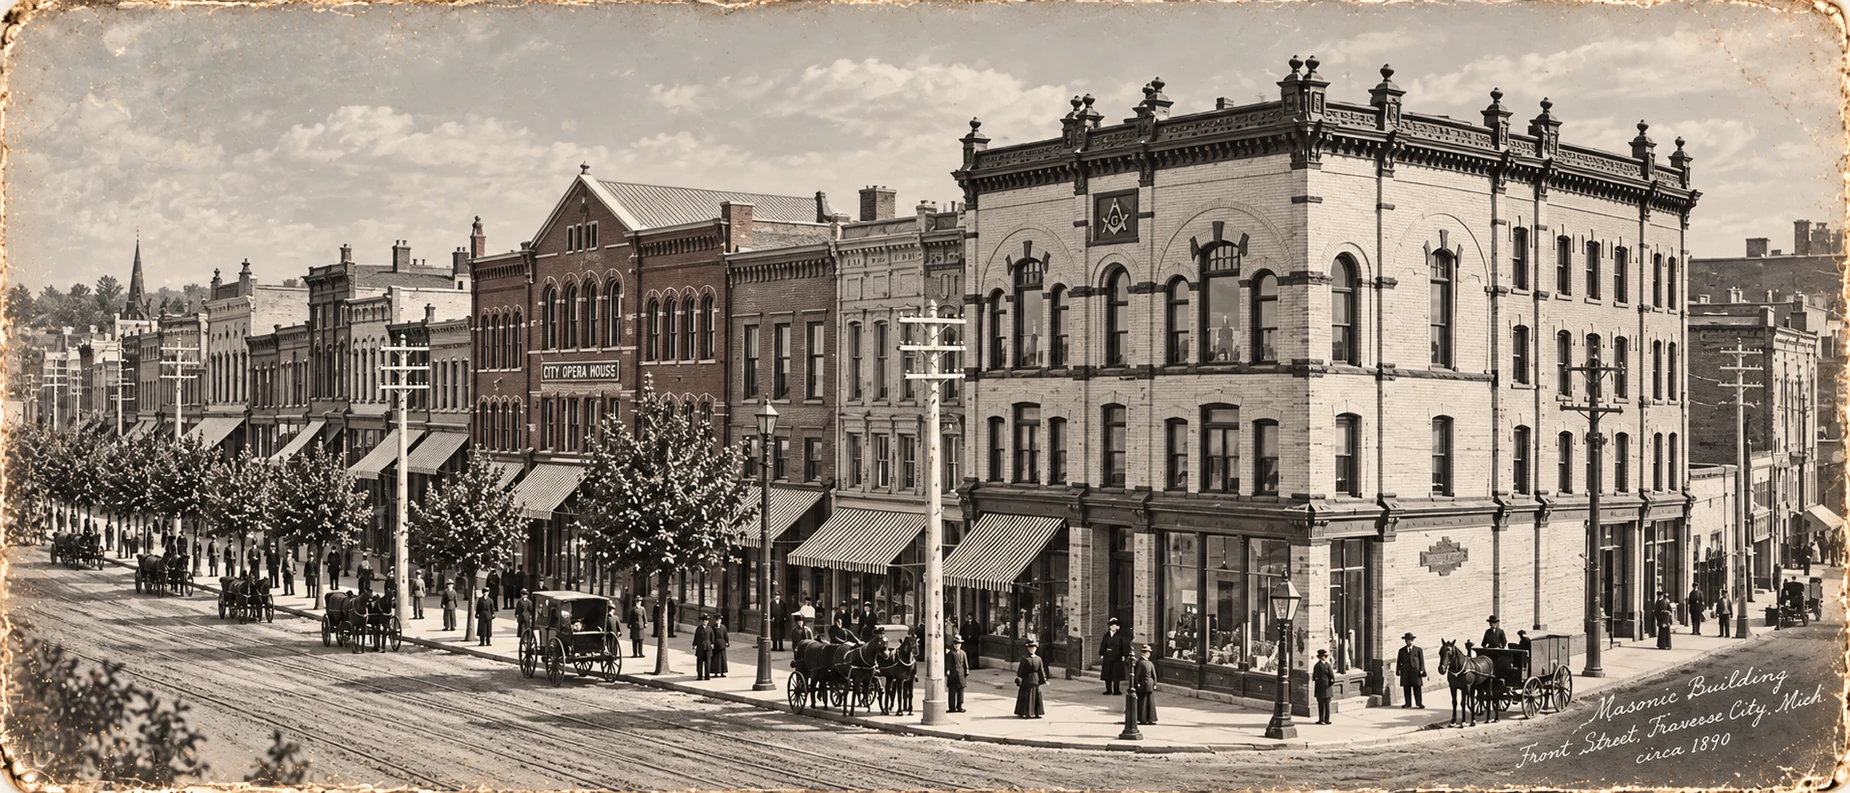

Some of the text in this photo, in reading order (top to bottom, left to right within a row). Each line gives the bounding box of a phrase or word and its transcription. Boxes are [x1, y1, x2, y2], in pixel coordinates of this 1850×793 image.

[1110, 215, 1119, 226] G
[543, 365, 560, 379] CITY
[562, 365, 587, 379] OPERA
